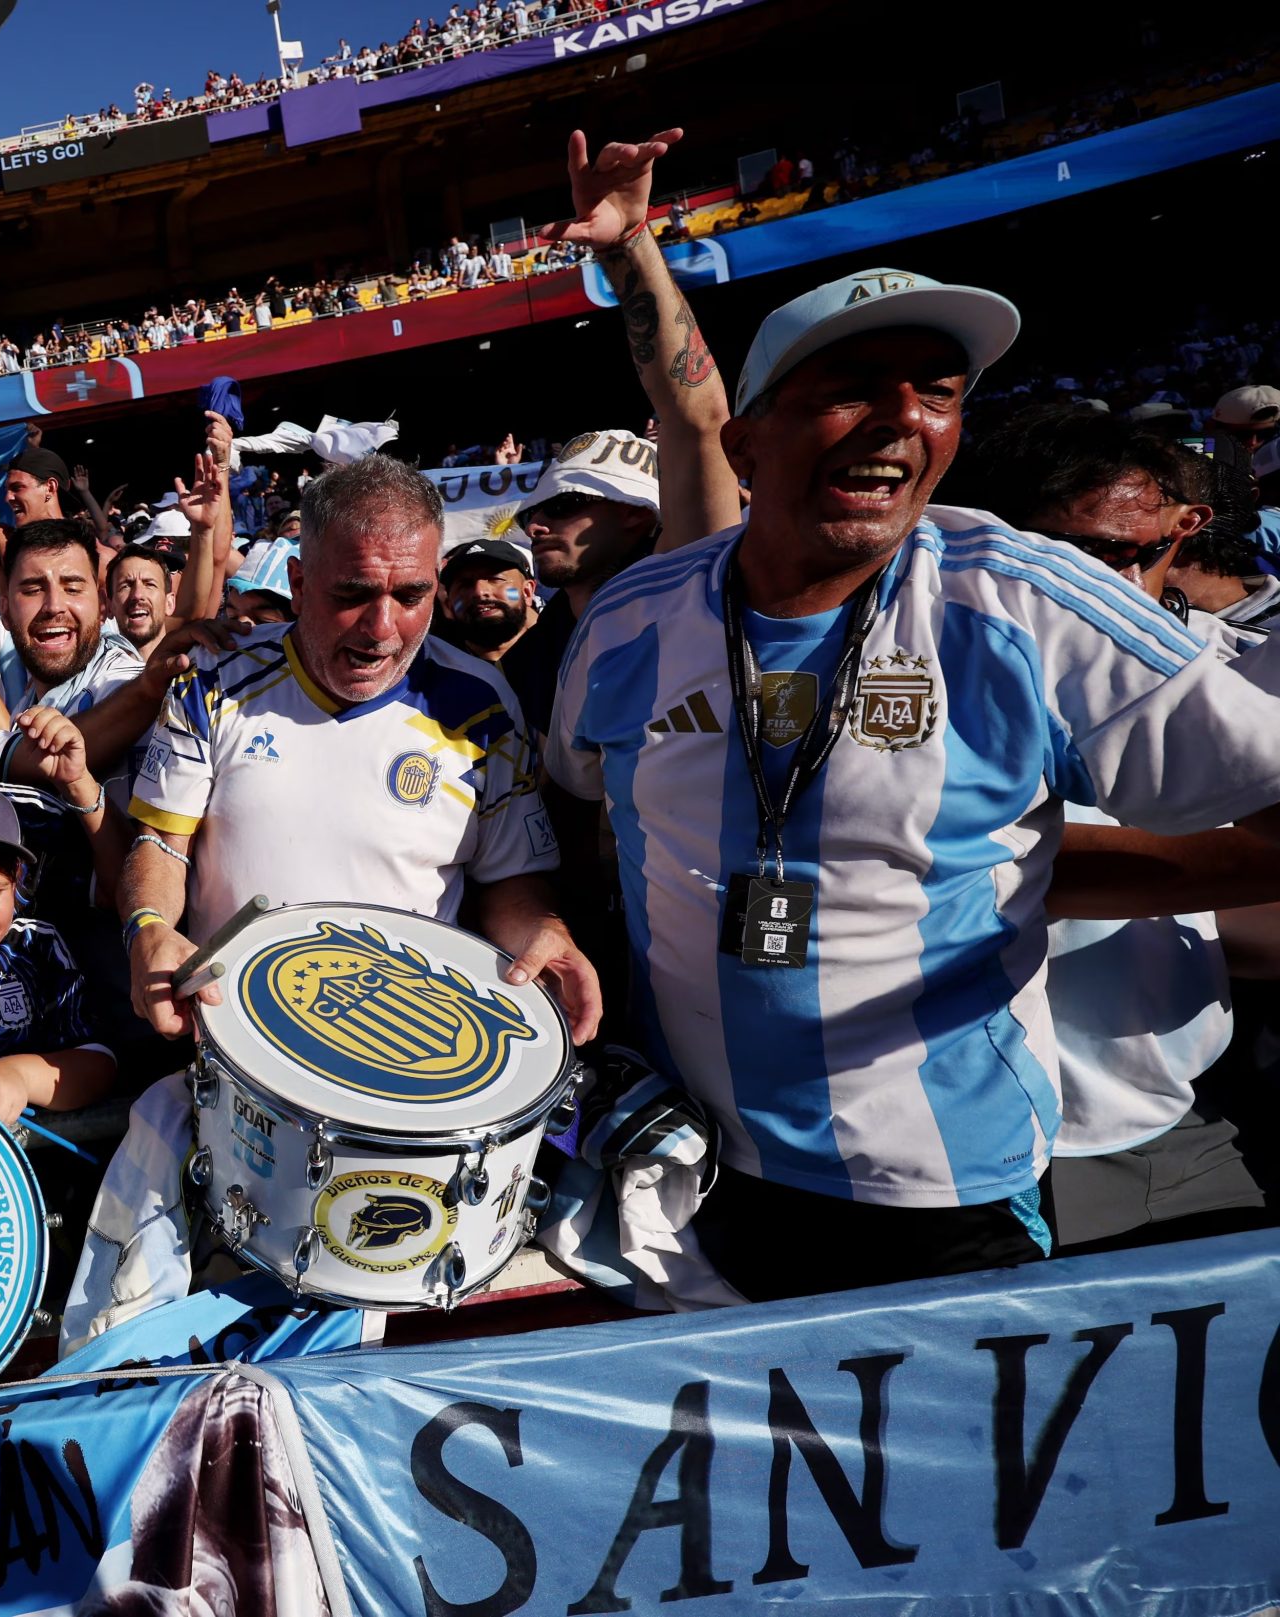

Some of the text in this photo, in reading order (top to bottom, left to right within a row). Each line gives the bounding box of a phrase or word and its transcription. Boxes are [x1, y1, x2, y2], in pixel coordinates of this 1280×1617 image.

[0, 142, 84, 171] LET'S GO!
[1057, 161, 1071, 182] A
[392, 319, 403, 337] D
[766, 719, 796, 729] FIFA
[868, 694, 916, 731] AFA
[4, 995, 23, 1015] AFA
[313, 972, 383, 1017] CARC
[233, 1094, 277, 1138] GOAT
[255, 1148, 276, 1166] LAGER
[325, 1173, 393, 1198] Dueños
[398, 1174, 423, 1188] de
[330, 1245, 408, 1273] Guerreros
[410, 1346, 919, 1617] SAN
